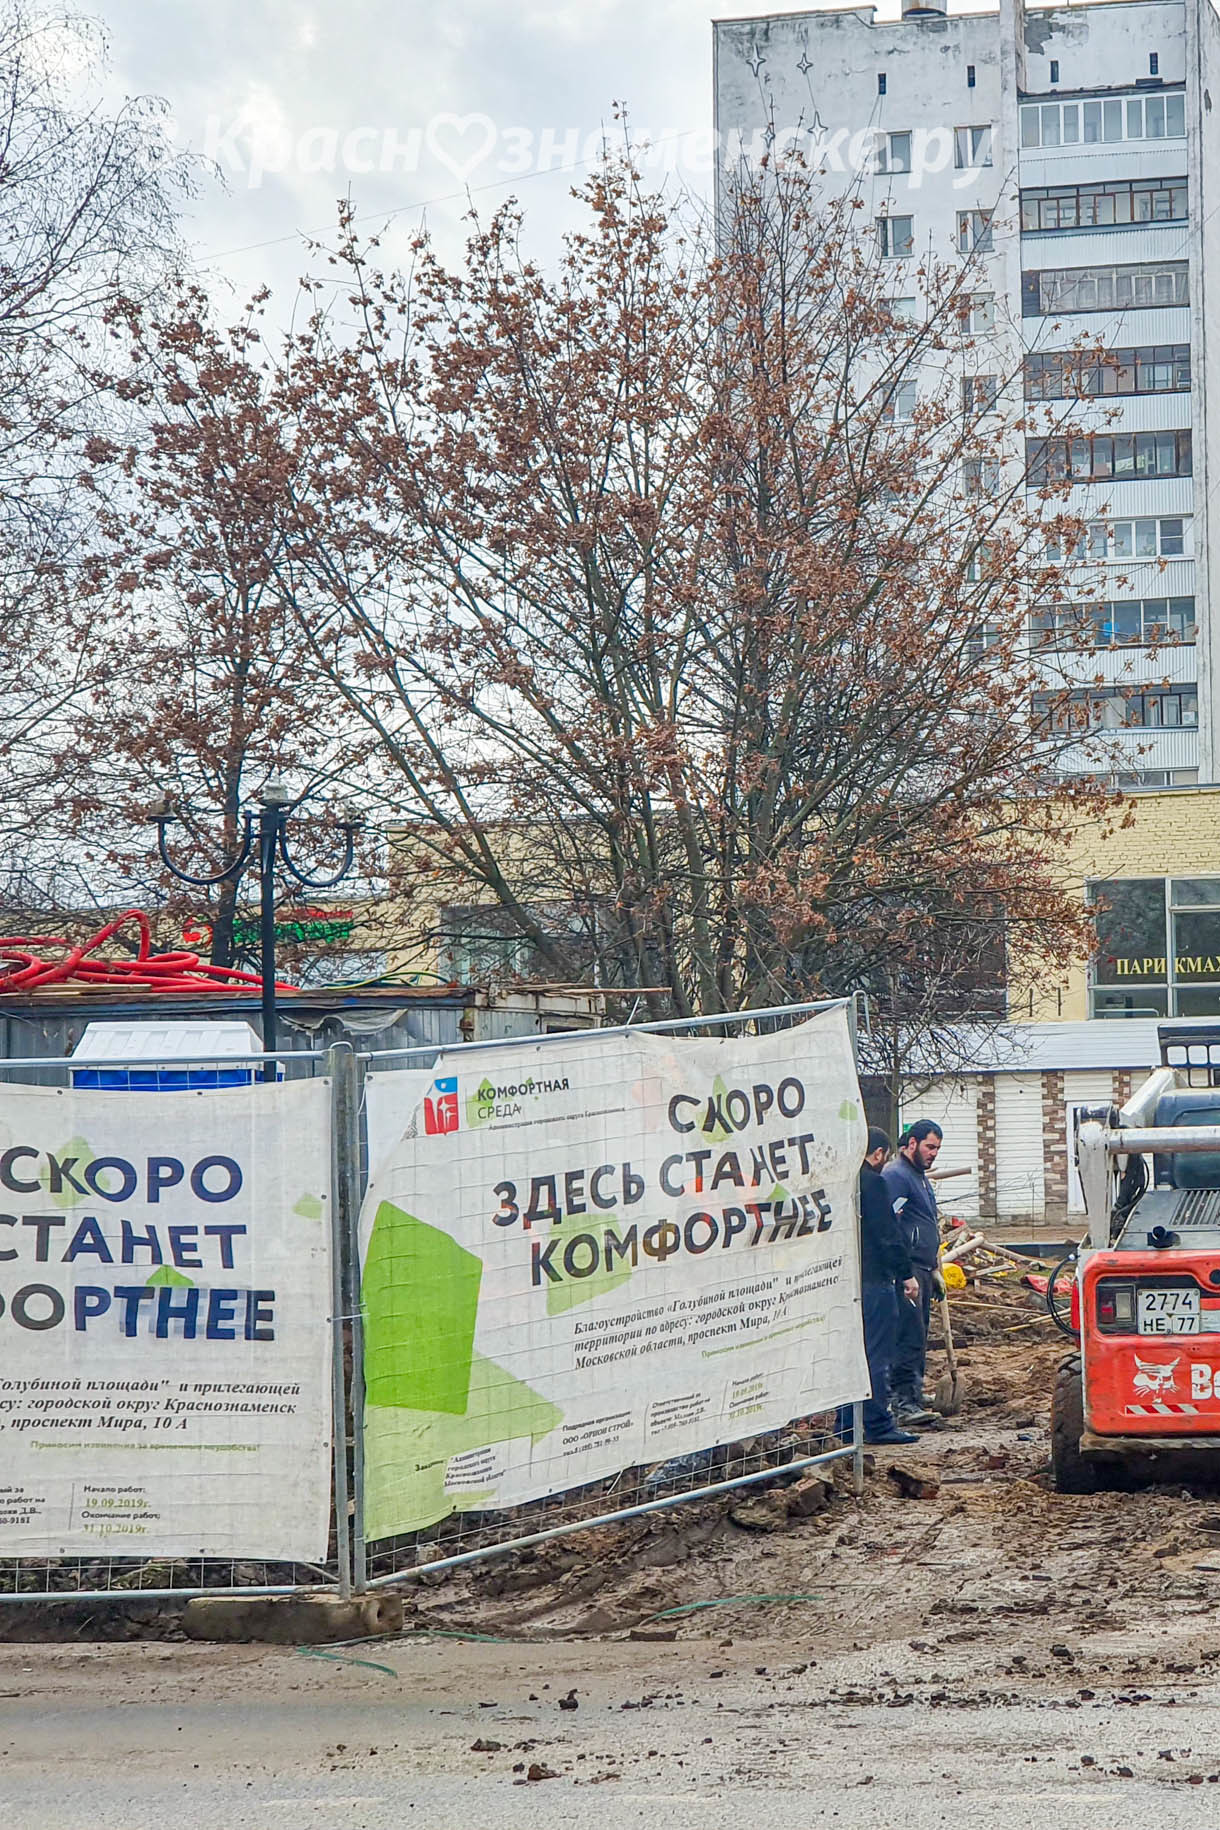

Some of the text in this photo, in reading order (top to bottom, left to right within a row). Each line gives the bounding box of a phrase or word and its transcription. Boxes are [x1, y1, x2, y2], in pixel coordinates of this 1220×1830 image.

[477, 1077, 569, 1102] КОМФОРТНАЯ
[477, 1103, 521, 1119] СРЕДА
[668, 1077, 806, 1134] СКОРО
[0, 1145, 243, 1203] СКОРО
[492, 1133, 815, 1230] ЗДЕСЬ СТАНЕТ
[531, 1189, 833, 1287] КОМФОРТНЕЕ
[0, 1283, 276, 1341] ОРТНЕЕ
[574, 1306, 665, 1335] Благоустройство
[667, 1290, 725, 1313] «Голубиной
[728, 1277, 779, 1300] площади"
[785, 1276, 792, 1286] и
[1145, 1293, 1192, 1311] 2774
[574, 1329, 642, 1353] территории
[645, 1325, 658, 1338] по
[660, 1316, 693, 1334] адресу:
[695, 1303, 746, 1325] городской
[748, 1296, 777, 1314] округ
[1177, 1317, 1195, 1332] 77
[575, 1344, 637, 1370] Московской
[640, 1335, 686, 1355] области,
[688, 1322, 737, 1345] проспект
[740, 1314, 771, 1330] Мира,
[86, 1379, 170, 1393] площади"
[178, 1382, 188, 1392] и
[193, 1382, 301, 1397] прилегающей
[27, 1397, 111, 1412] городской
[116, 1399, 160, 1414] округ
[164, 1398, 297, 1414] Краснознаменск
[11, 1415, 188, 1431] проспект Мира, 10 А
[83, 1485, 146, 1495] Начало работ:
[81, 1511, 131, 1519] Окончание
